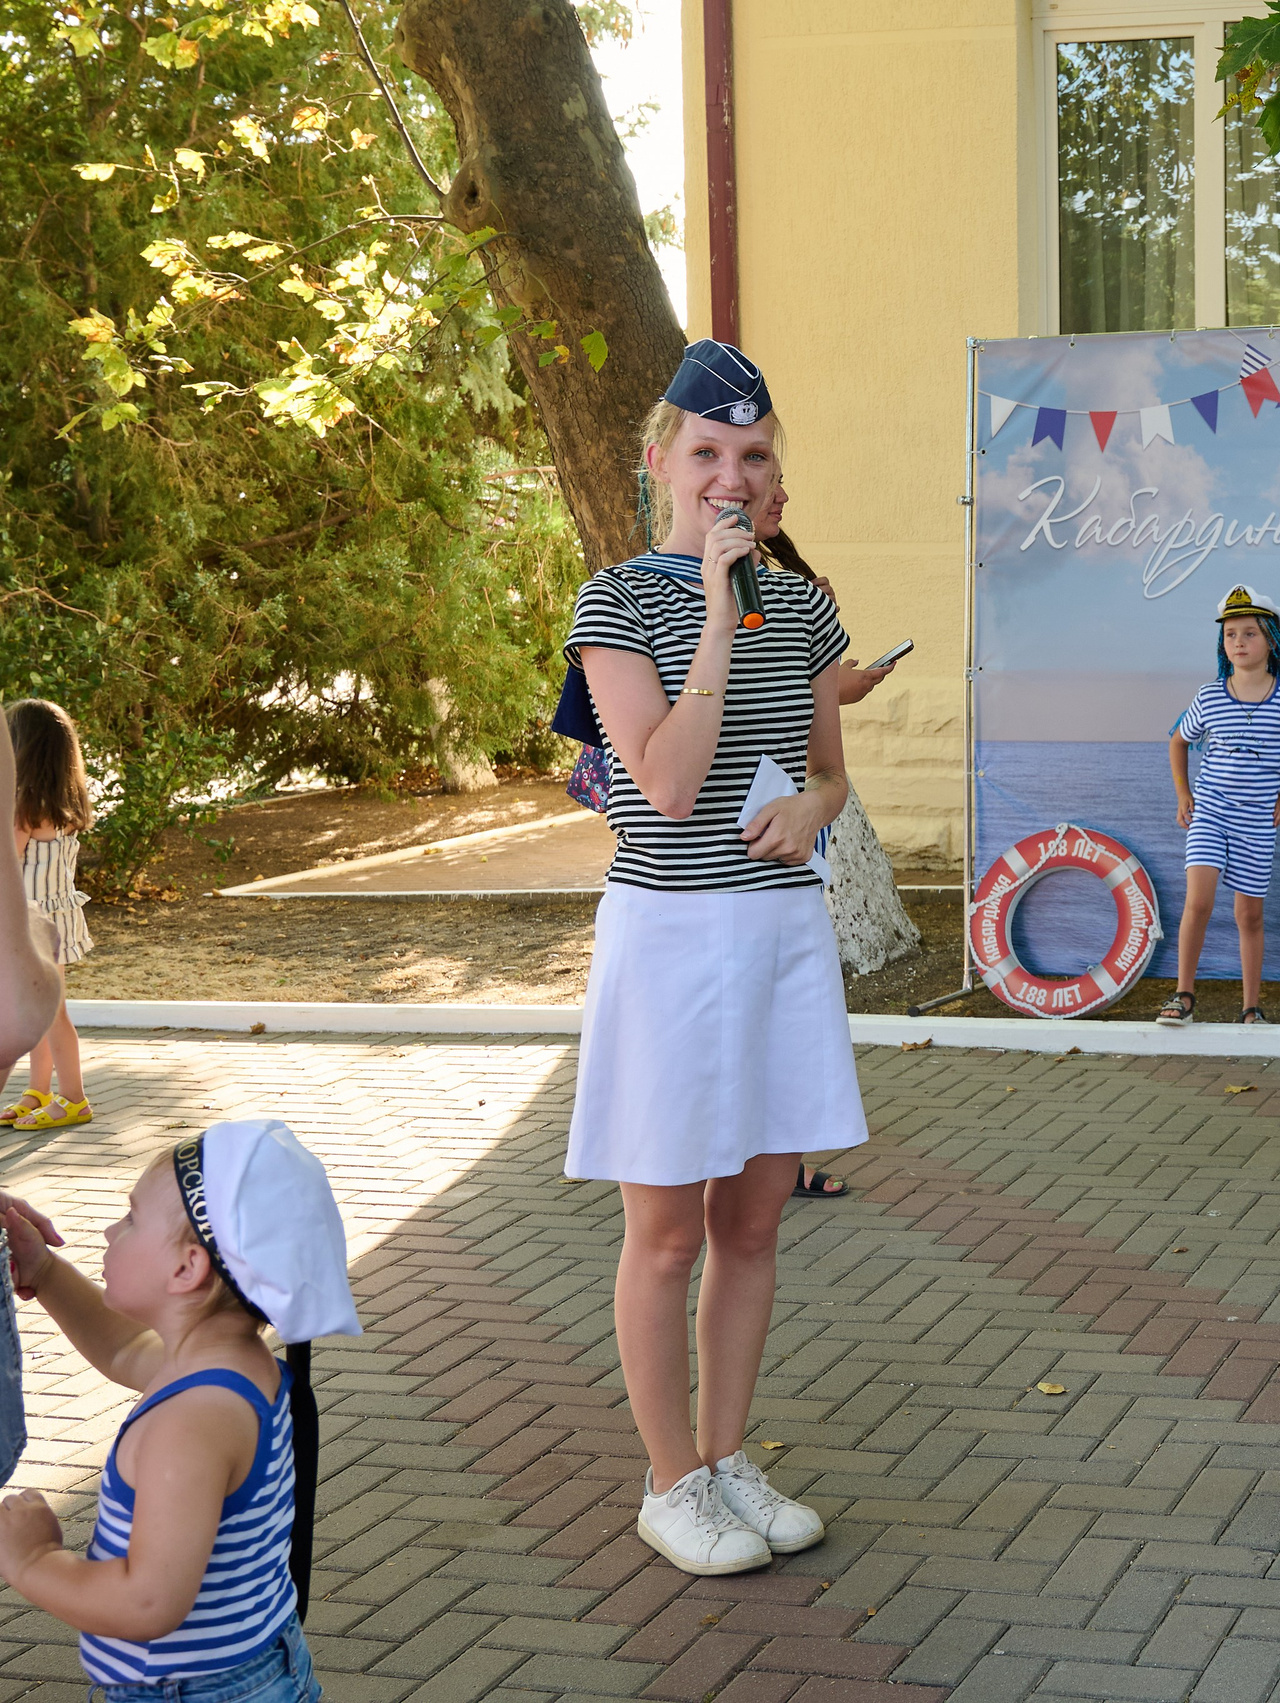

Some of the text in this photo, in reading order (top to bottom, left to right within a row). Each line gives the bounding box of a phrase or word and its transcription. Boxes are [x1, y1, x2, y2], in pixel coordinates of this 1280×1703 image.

[1038, 838, 1106, 863] 188 ЛЕТ
[981, 873, 1012, 964] КАБАРДИНКА
[1114, 885, 1149, 972] КАБАРДИНКА
[1015, 981, 1082, 1008] 188 ЛЕТ
